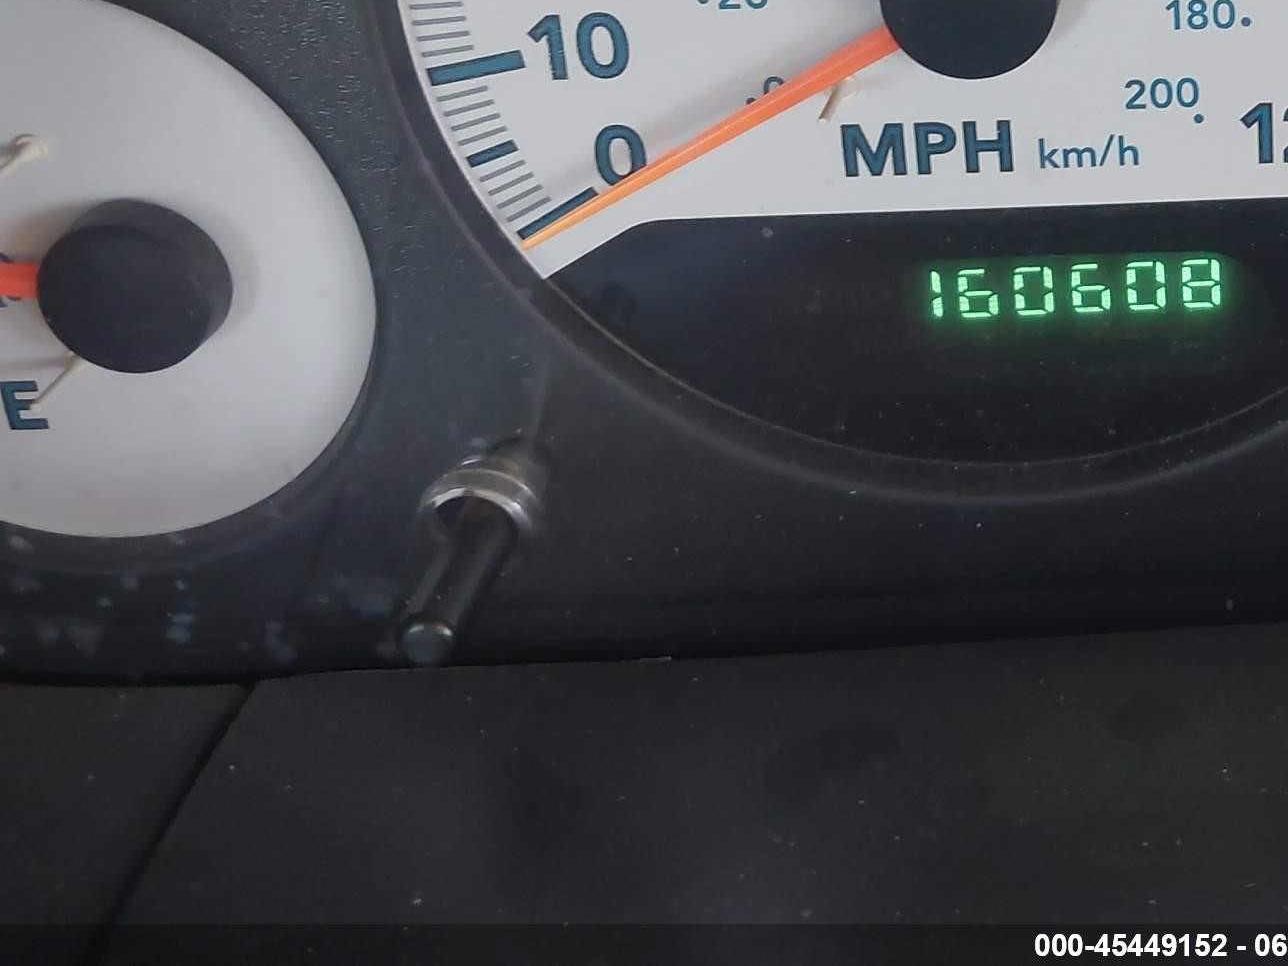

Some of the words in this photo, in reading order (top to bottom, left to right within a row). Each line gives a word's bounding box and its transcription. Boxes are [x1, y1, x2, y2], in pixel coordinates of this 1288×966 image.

[527, 12, 629, 80] 10
[1125, 78, 1199, 109] 200
[595, 125, 646, 186] 0
[840, 120, 1014, 177] MPH
[1038, 135, 1139, 168] km/h
[930, 258, 1221, 320] 160608
[0, 381, 49, 430] E
